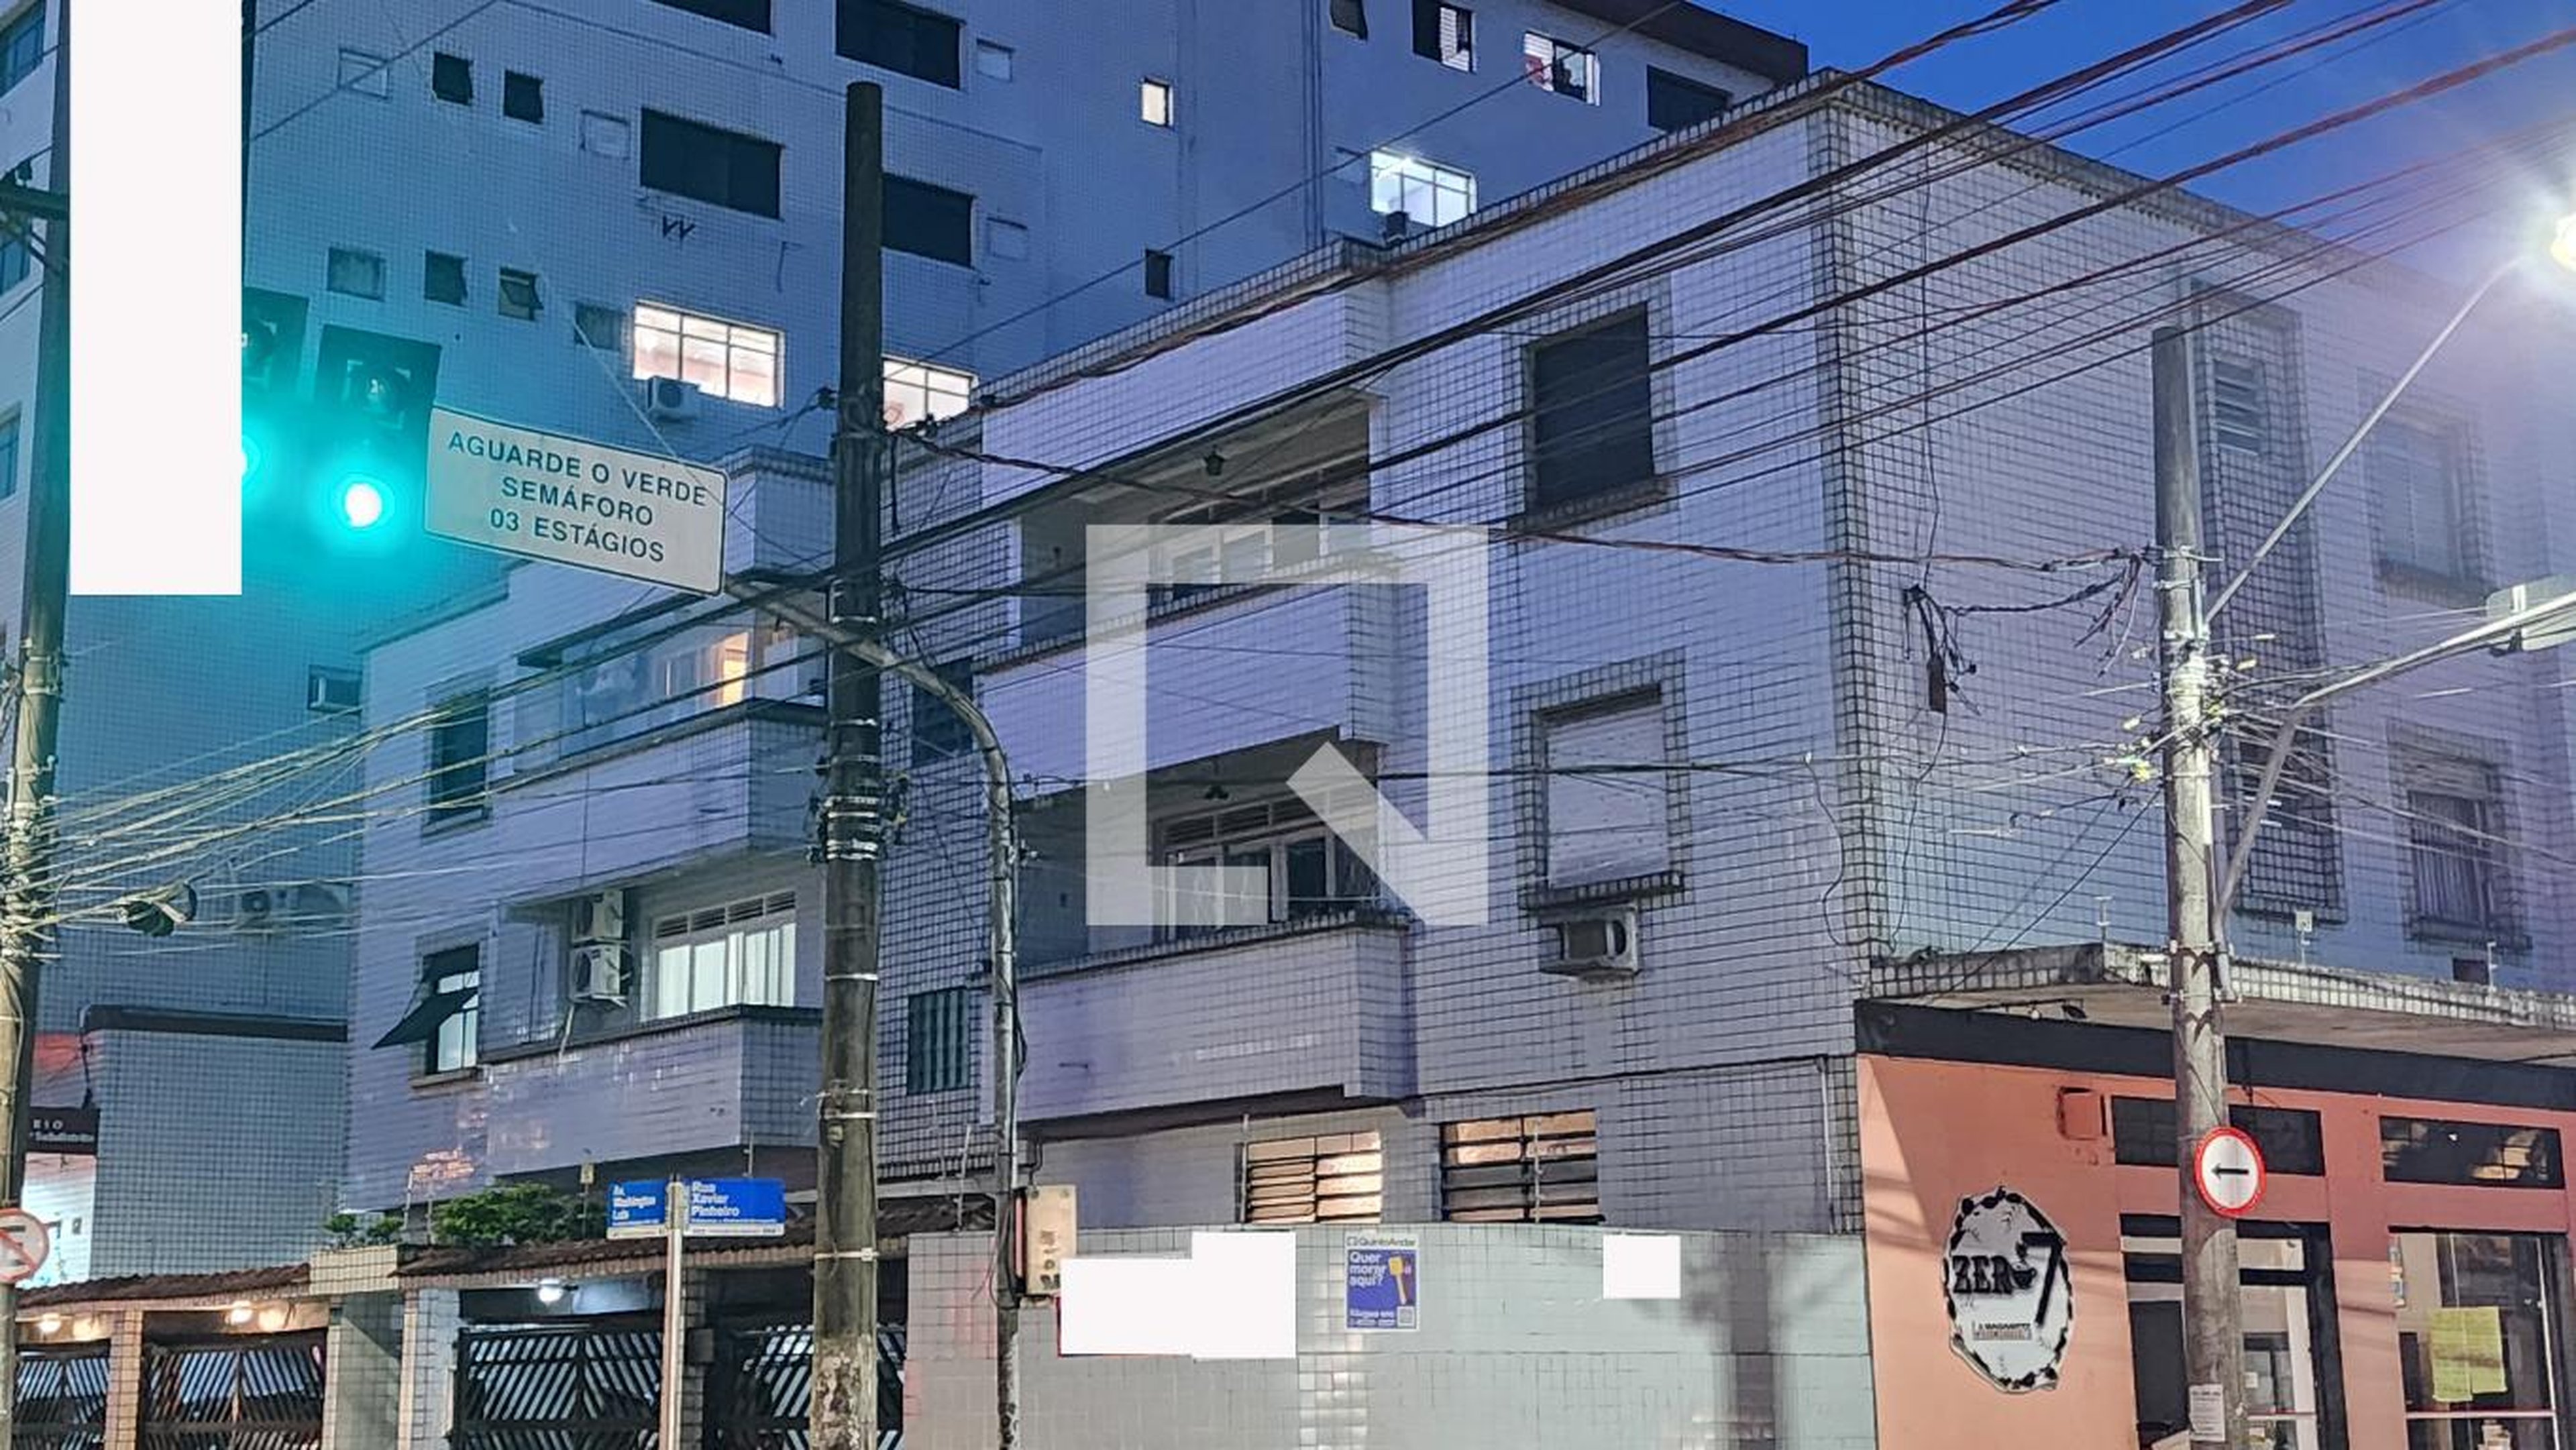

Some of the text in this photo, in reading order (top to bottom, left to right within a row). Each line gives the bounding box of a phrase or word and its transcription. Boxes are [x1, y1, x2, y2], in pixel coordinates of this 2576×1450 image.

[448, 432, 706, 506] AGUARDE O VERDE
[501, 477, 653, 526] SEMÁFORO
[490, 509, 664, 562] 03 ESTÁGIOS
[692, 1181, 716, 1192] Rua
[692, 1193, 729, 1204] Xavier
[691, 1206, 740, 1217] Pinheiro
[1350, 1251, 1381, 1264] Quer
[1350, 1275, 1383, 1288] aqui?
